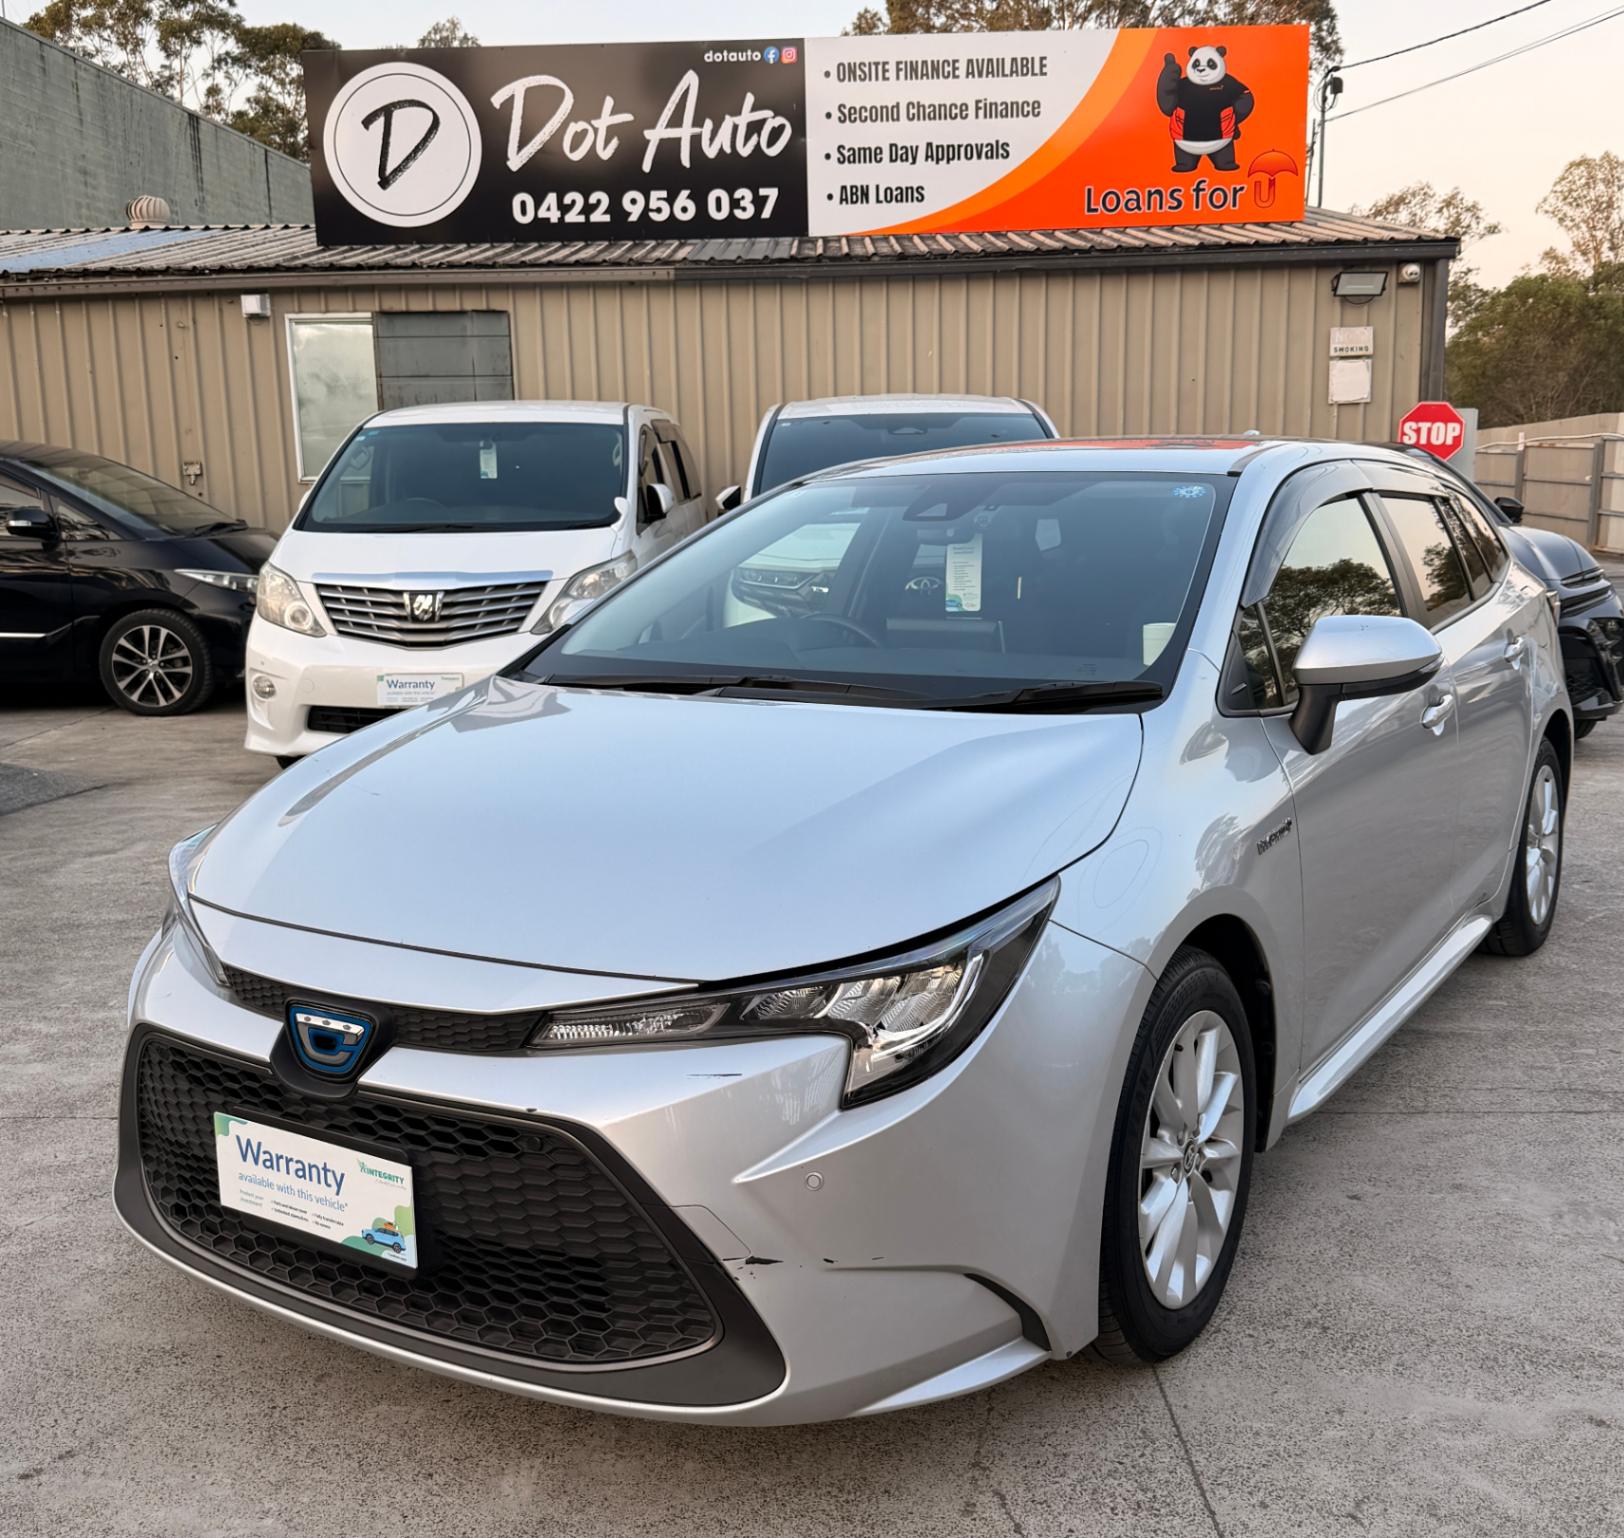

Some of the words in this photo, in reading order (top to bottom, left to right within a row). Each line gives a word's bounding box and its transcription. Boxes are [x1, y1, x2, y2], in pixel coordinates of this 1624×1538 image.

[704, 49, 762, 64] dotauto
[836, 61, 891, 83] ONSITE
[895, 59, 960, 81] FINANCE
[965, 56, 1048, 79] AVAILABLE
[490, 75, 634, 172] Dot
[642, 69, 792, 173] Auto
[837, 101, 901, 124] Second
[905, 99, 969, 122] Chance
[974, 98, 1041, 120] Finance
[361, 99, 441, 191] D
[836, 143, 884, 165] Same
[888, 142, 919, 165] Day
[924, 139, 1011, 165] Approvals
[511, 191, 611, 224] 0422
[621, 189, 696, 223] 956
[706, 187, 779, 220] 037
[839, 184, 870, 205] ABN
[875, 183, 925, 204] Loans
[1085, 185, 1185, 215] Loans
[1191, 177, 1246, 210] for
[1254, 177, 1276, 209] U
[1403, 421, 1461, 446] STOP
[386, 679, 436, 690] Warranty
[236, 1134, 345, 1196] Warranty
[366, 1167, 405, 1185] INTEGRITY
[238, 1172, 275, 1190] available
[276, 1183, 295, 1197] with
[297, 1188, 313, 1202] this
